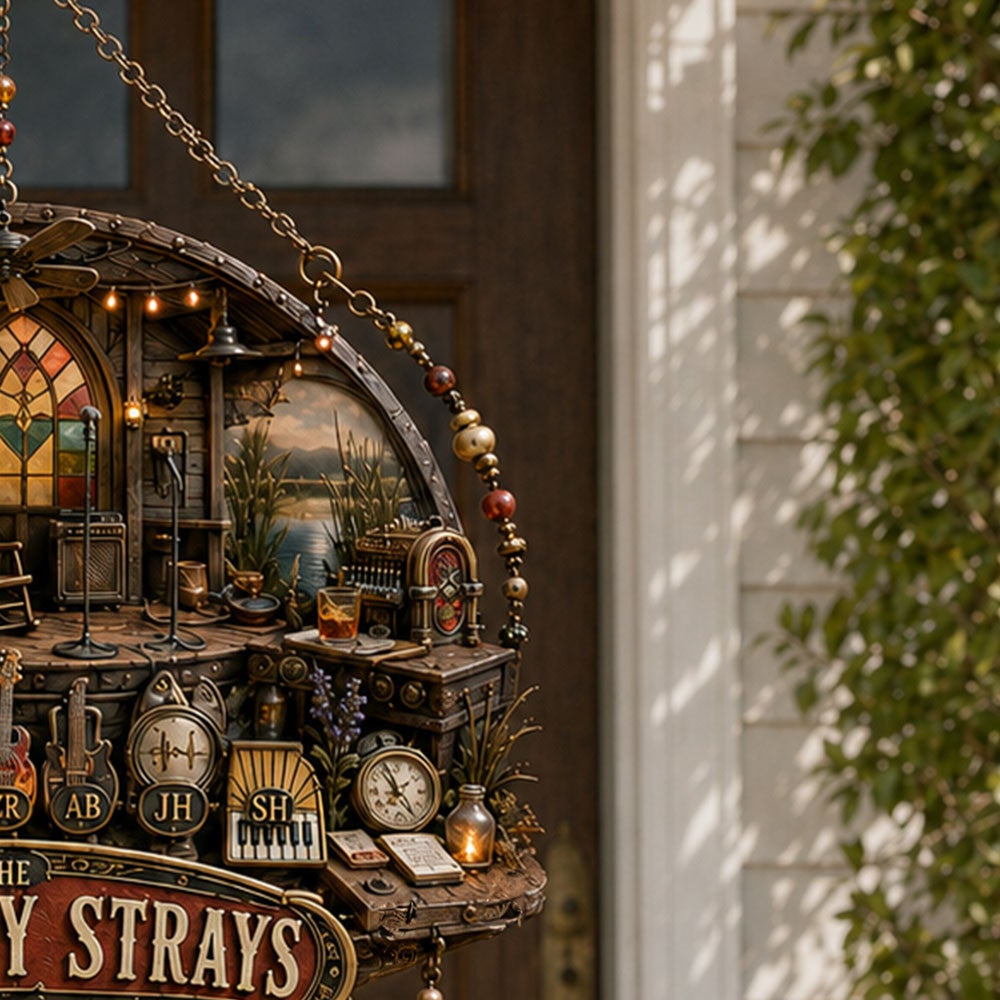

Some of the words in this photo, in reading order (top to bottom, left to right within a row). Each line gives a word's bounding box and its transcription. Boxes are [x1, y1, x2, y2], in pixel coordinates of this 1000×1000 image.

[64, 793, 101, 820] AB
[154, 792, 193, 822] JH
[252, 795, 288, 822] SH
[67, 894, 302, 998] STRAYS
